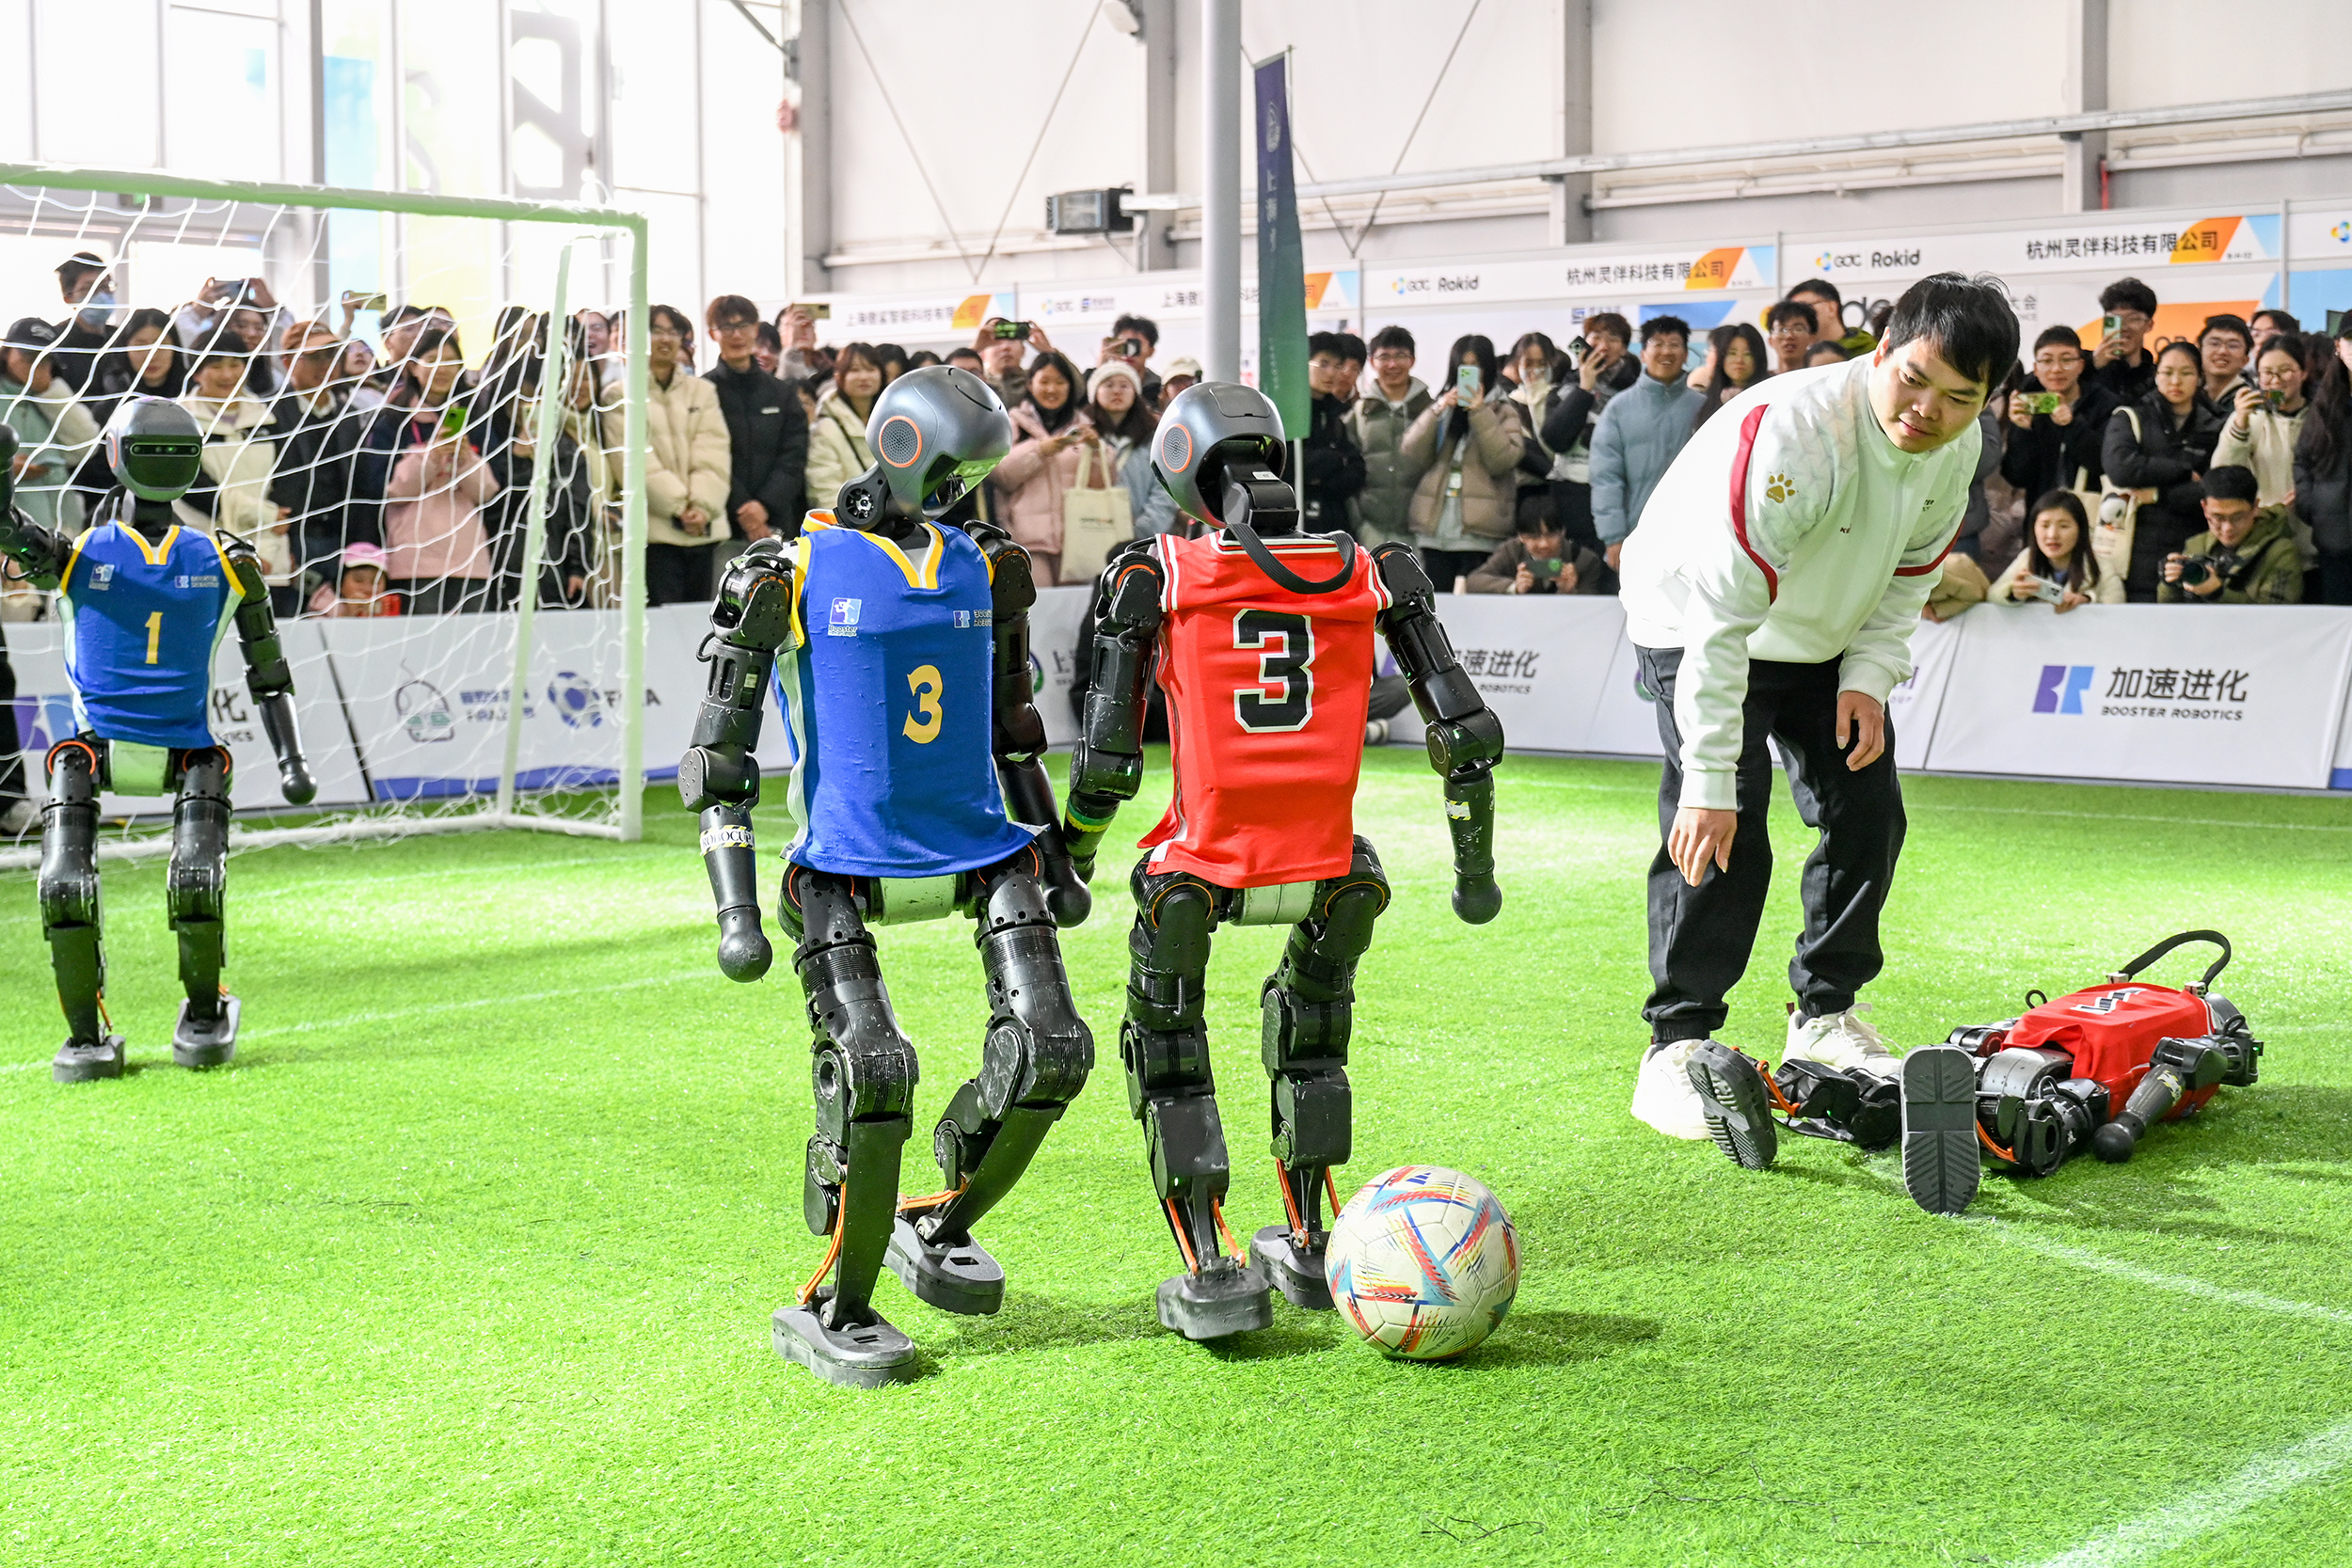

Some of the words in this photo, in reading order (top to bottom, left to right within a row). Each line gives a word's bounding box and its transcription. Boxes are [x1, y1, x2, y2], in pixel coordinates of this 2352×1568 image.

[1871, 249, 1920, 268] Rokid
[2026, 230, 2218, 260] 杭州灵伴科技有限公司
[1438, 276, 1479, 292] Rokid
[1566, 261, 1724, 286] 杭州灵伴科技有限公司
[144, 611, 164, 664] 1
[1232, 608, 1315, 734] 3
[2106, 667, 2249, 703] 加速进化
[902, 664, 944, 744] 3
[2101, 705, 2166, 719] BOOSTER
[2171, 708, 2243, 721] ROBOTICS
